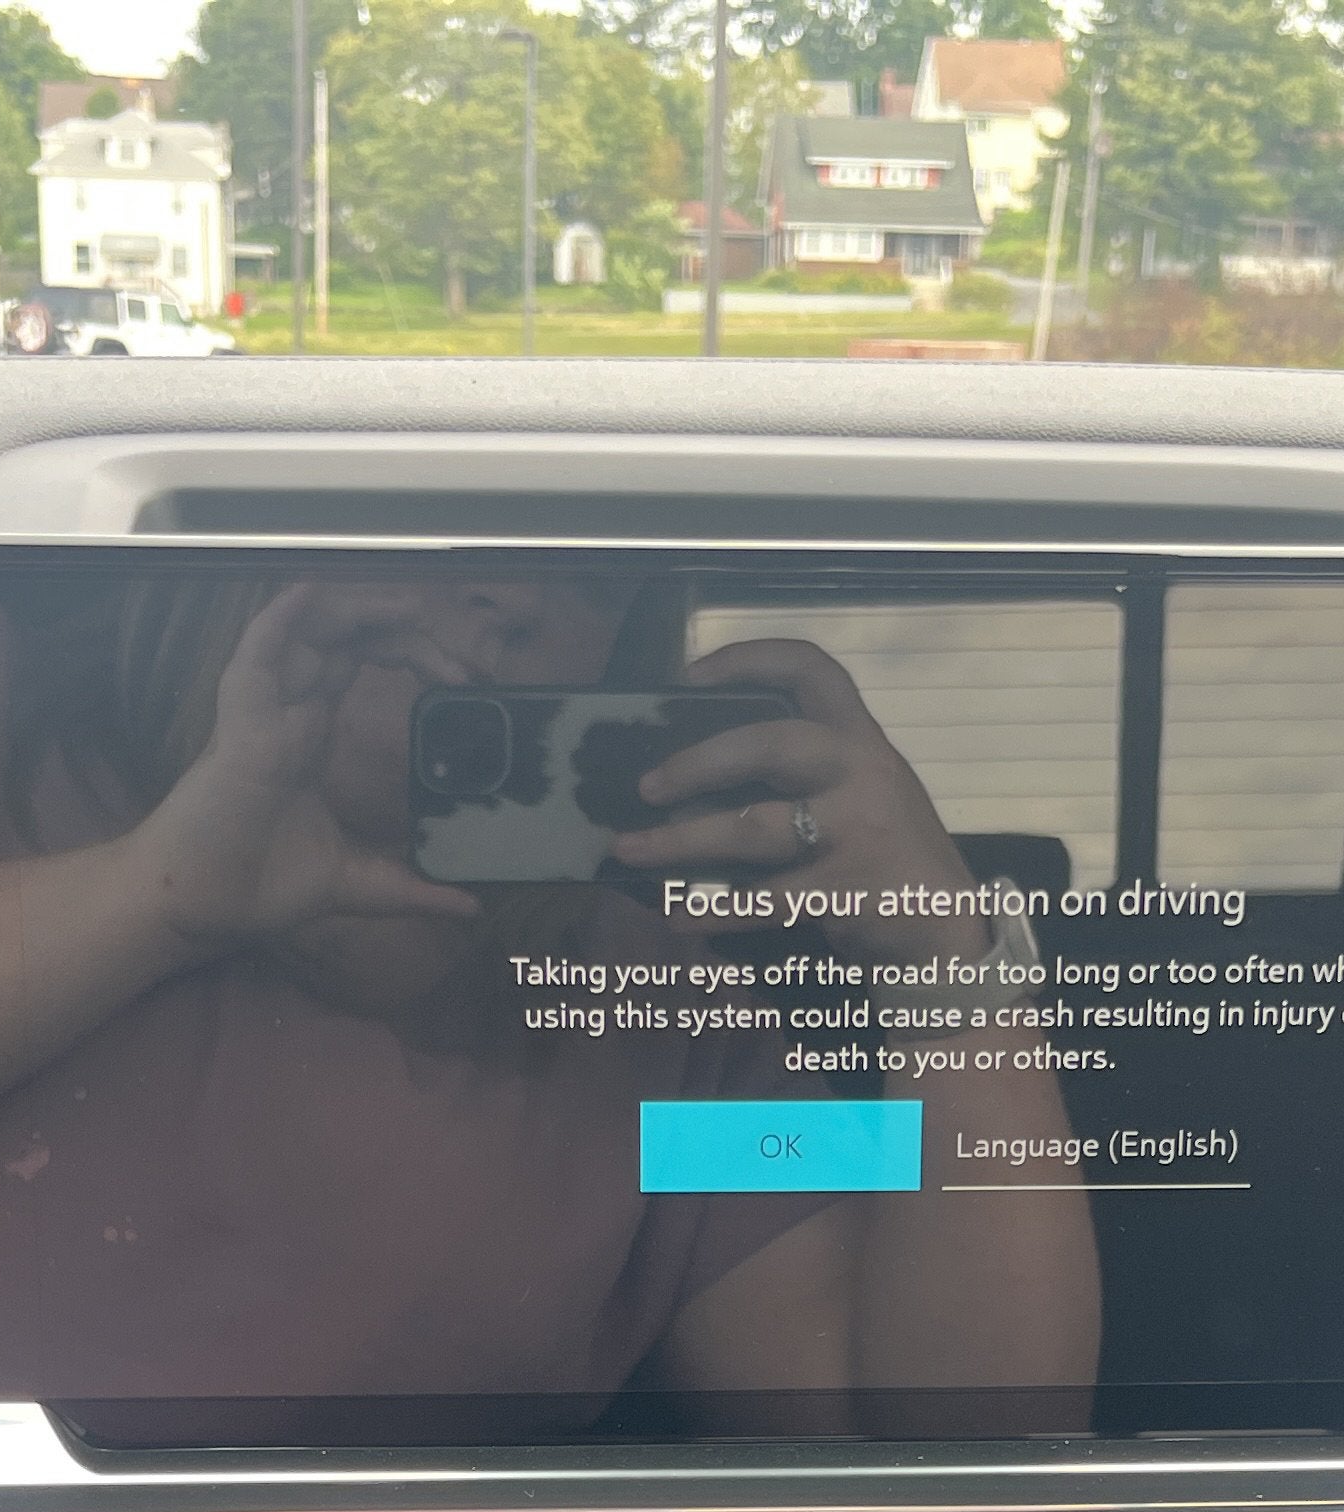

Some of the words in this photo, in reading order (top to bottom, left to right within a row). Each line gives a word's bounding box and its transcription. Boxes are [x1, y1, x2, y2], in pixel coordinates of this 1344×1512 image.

[663, 879, 775, 917] Focus
[783, 889, 869, 928] your
[877, 877, 1050, 918] attention
[1060, 888, 1107, 917] on
[1118, 877, 1245, 927] driving
[509, 955, 607, 994] Taking
[613, 964, 682, 994] your
[688, 964, 756, 994] eyes
[763, 955, 811, 986] off
[814, 956, 863, 986] the
[872, 955, 938, 985] road
[946, 955, 991, 985] for
[996, 959, 1047, 985] too
[1055, 955, 1120, 993] long
[1128, 963, 1162, 984] or
[1166, 958, 1217, 984] too
[1224, 953, 1305, 984] often
[525, 1001, 605, 1037] using
[613, 999, 669, 1029] this
[677, 1003, 781, 1037] system
[789, 999, 870, 1029] could
[878, 1007, 963, 1028] cause
[970, 1007, 987, 1028] a
[995, 998, 1074, 1028] crash
[1082, 997, 1211, 1035] resulting
[1219, 999, 1245, 1027] in
[1253, 999, 1336, 1035] injury
[784, 1042, 868, 1072] death
[875, 1045, 907, 1071] to
[912, 1050, 966, 1079] you
[974, 1050, 1007, 1071] or
[1013, 1041, 1116, 1070] others.
[760, 1133, 803, 1159] OK
[956, 1132, 1100, 1166] Language
[1108, 1128, 1239, 1165] (English)
